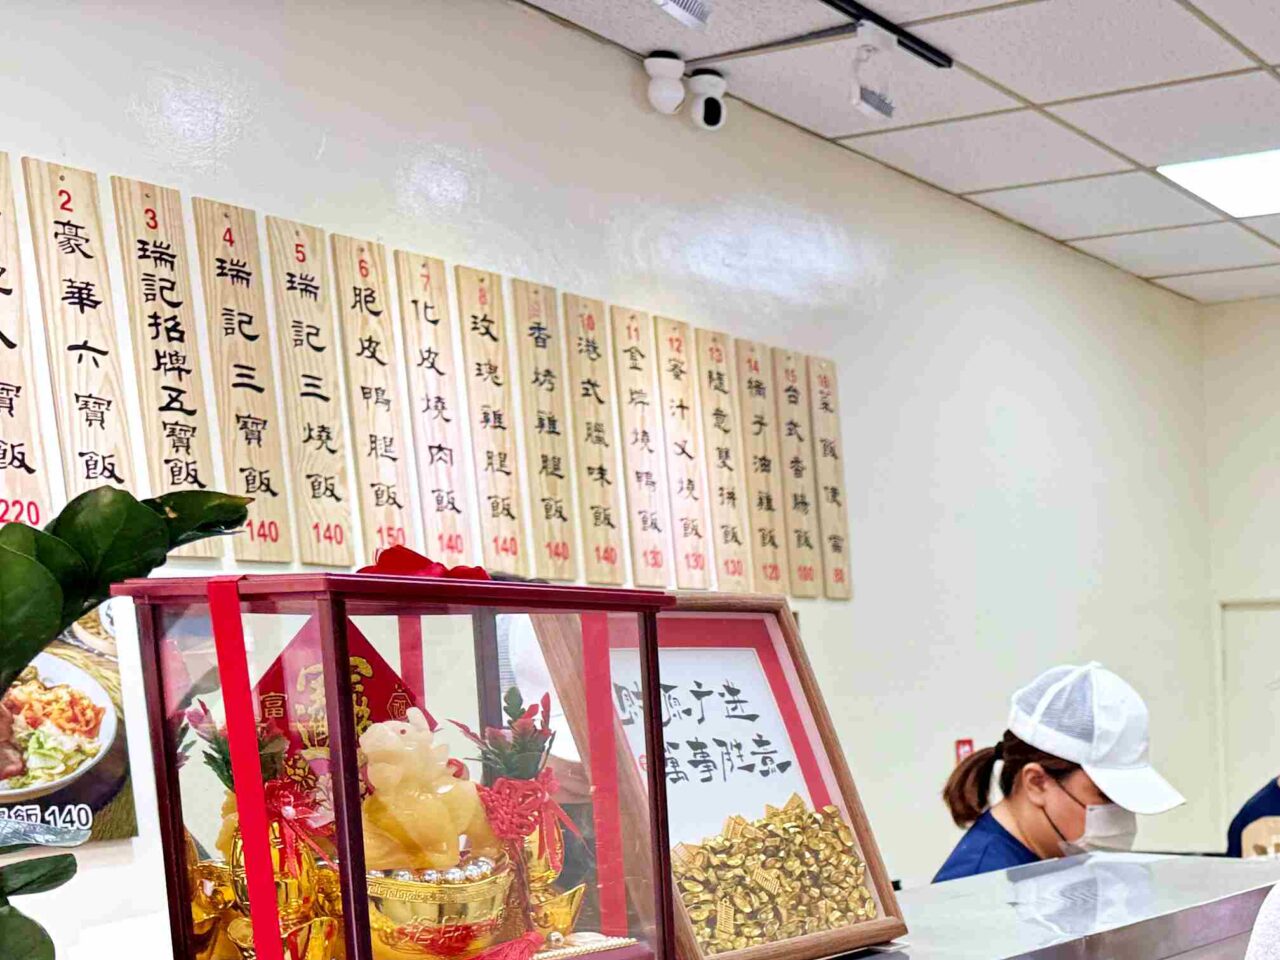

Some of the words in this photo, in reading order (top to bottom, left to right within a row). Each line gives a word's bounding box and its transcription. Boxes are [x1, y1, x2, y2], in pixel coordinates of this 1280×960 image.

[58, 189, 73, 212] 2
[144, 208, 158, 230] 3
[223, 227, 235, 248] 4
[295, 244, 307, 263] 5
[420, 273, 431, 291] 7
[54, 219, 125, 484] 豪華六寶飯
[137, 239, 207, 488] 瑞記招牌五寶飯
[215, 257, 279, 497] 瑞記三寶飯
[286, 272, 342, 502] 瑞記三燒飯
[358, 259, 369, 278] 6
[377, 527, 406, 546] 150
[411, 300, 462, 514] 化皮燒肉飯
[470, 313, 516, 520] 玫瑰雞腿飯
[493, 536, 518, 556] 140
[625, 323, 640, 341] 11
[643, 550, 664, 569] 130
[669, 336, 683, 354] 12
[684, 553, 706, 570] 130
[246, 519, 279, 543] 140
[313, 522, 344, 545] 140
[438, 533, 464, 554] 140
[546, 541, 570, 560] 140
[45, 805, 92, 830] 140
